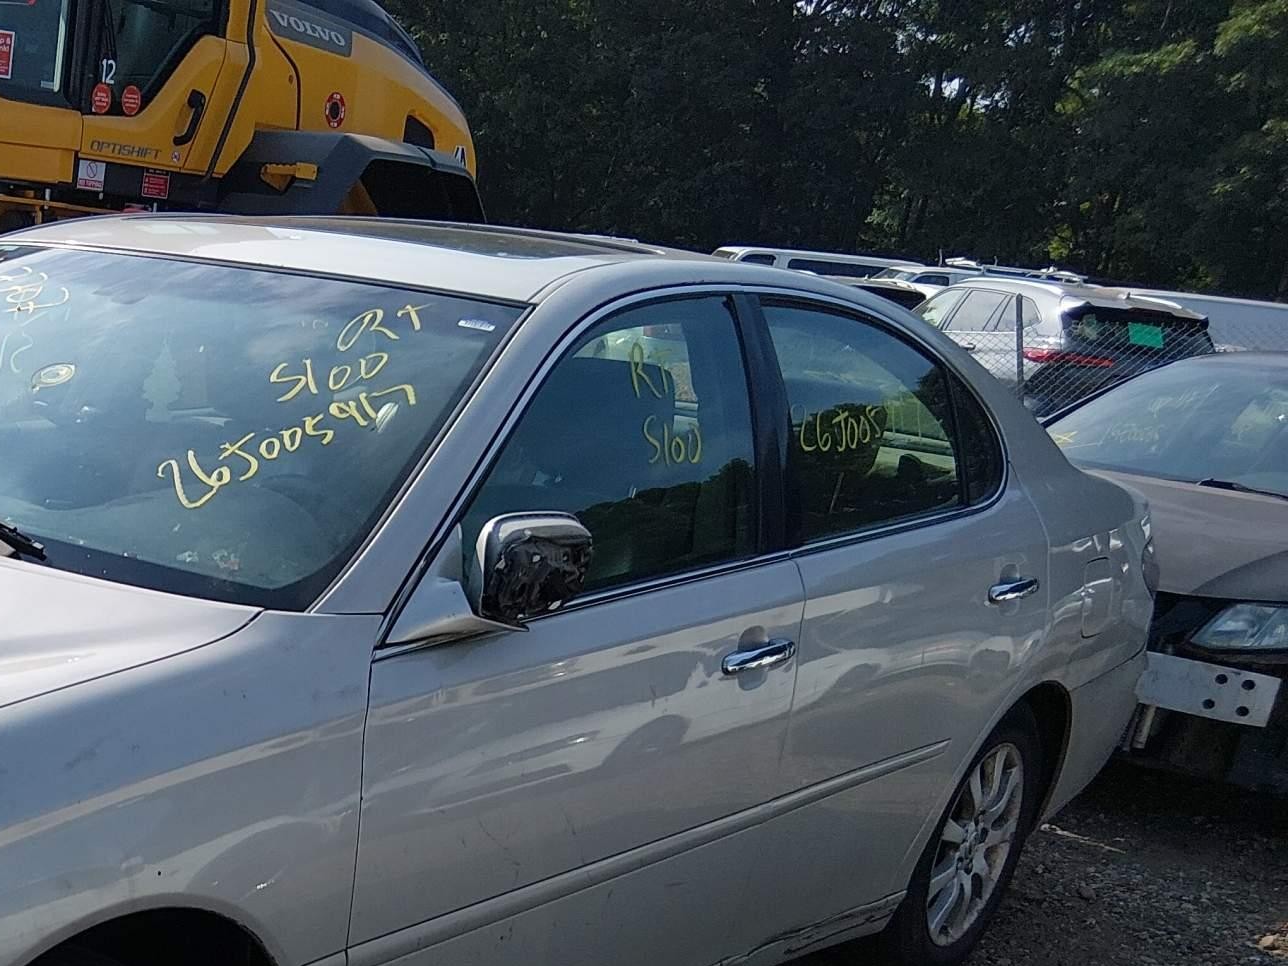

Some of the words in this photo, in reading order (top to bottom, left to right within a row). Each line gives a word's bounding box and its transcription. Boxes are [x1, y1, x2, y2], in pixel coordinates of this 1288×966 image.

[270, 9, 346, 46] VOLVO
[102, 58, 116, 84] 12
[90, 140, 162, 160] OPTISHIFT
